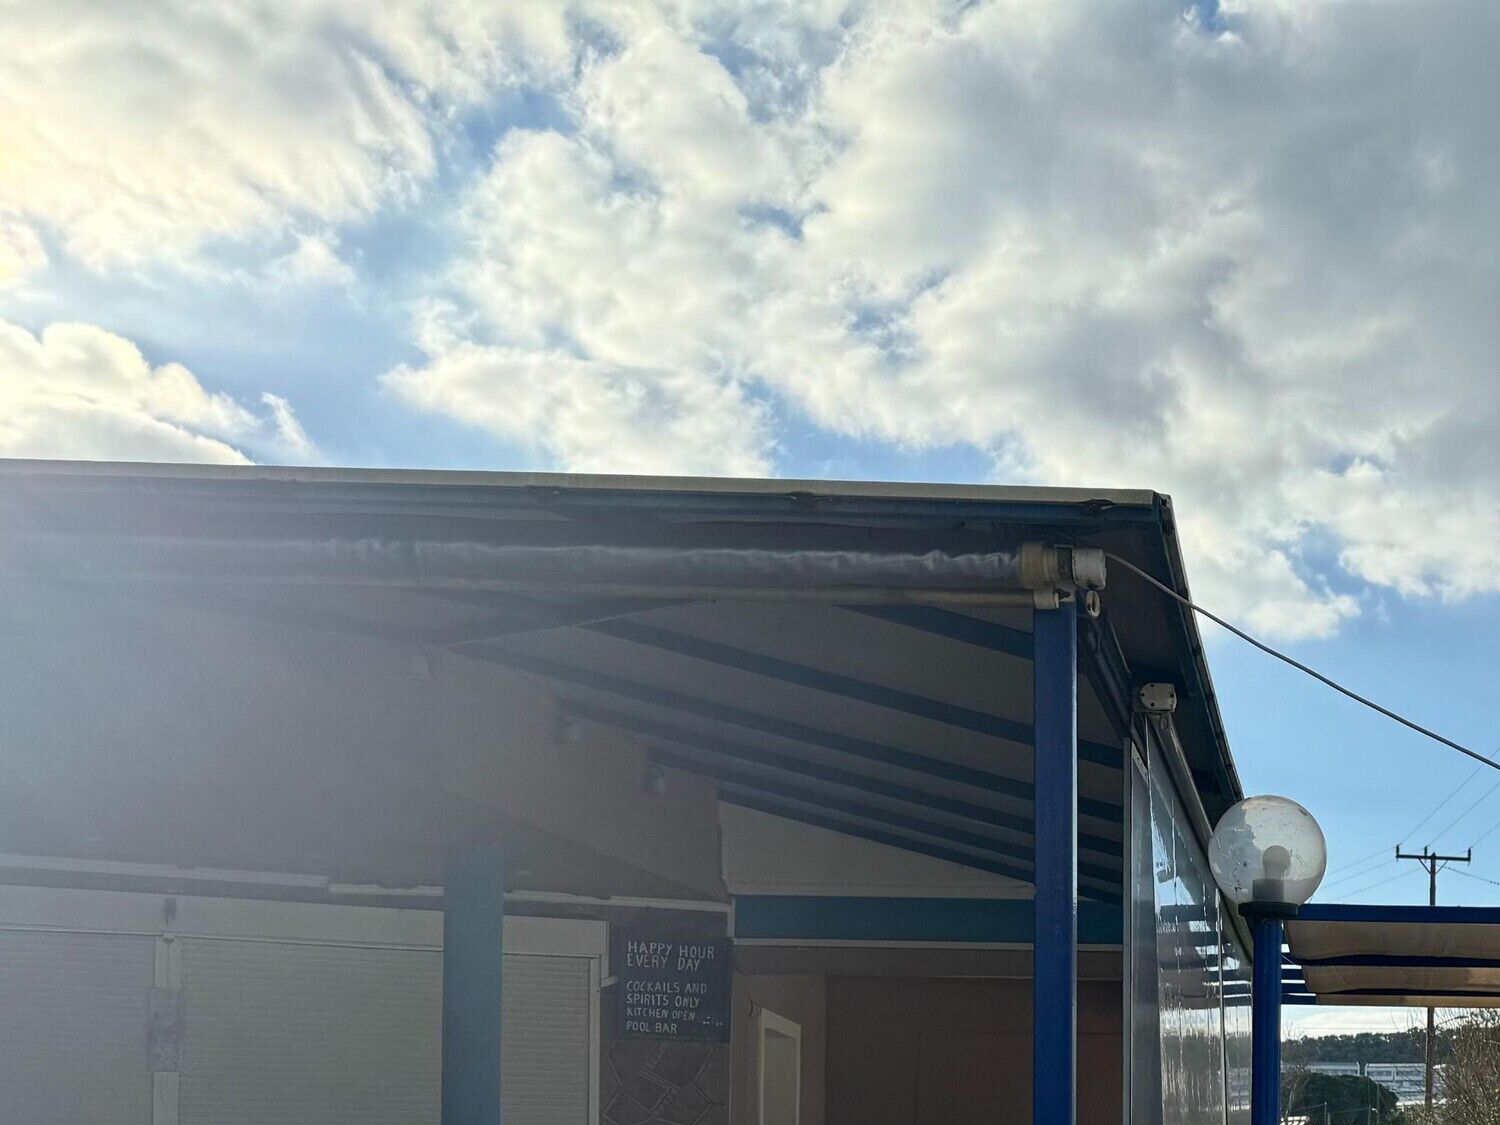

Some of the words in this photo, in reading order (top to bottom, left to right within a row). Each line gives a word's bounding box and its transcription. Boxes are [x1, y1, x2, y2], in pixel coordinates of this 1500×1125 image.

[628, 941, 673, 954] HAPPY
[679, 946, 714, 958] HOUR
[627, 954, 668, 968] EVERY
[678, 958, 700, 971] DAY
[685, 983, 707, 993] AND
[626, 994, 669, 1006] SPIRITS
[675, 996, 700, 1008] ONLY
[626, 1007, 669, 1019] KITCHEN
[672, 1010, 696, 1021] OPEN
[626, 1021, 649, 1031] POOL
[656, 1023, 679, 1033] BAR
